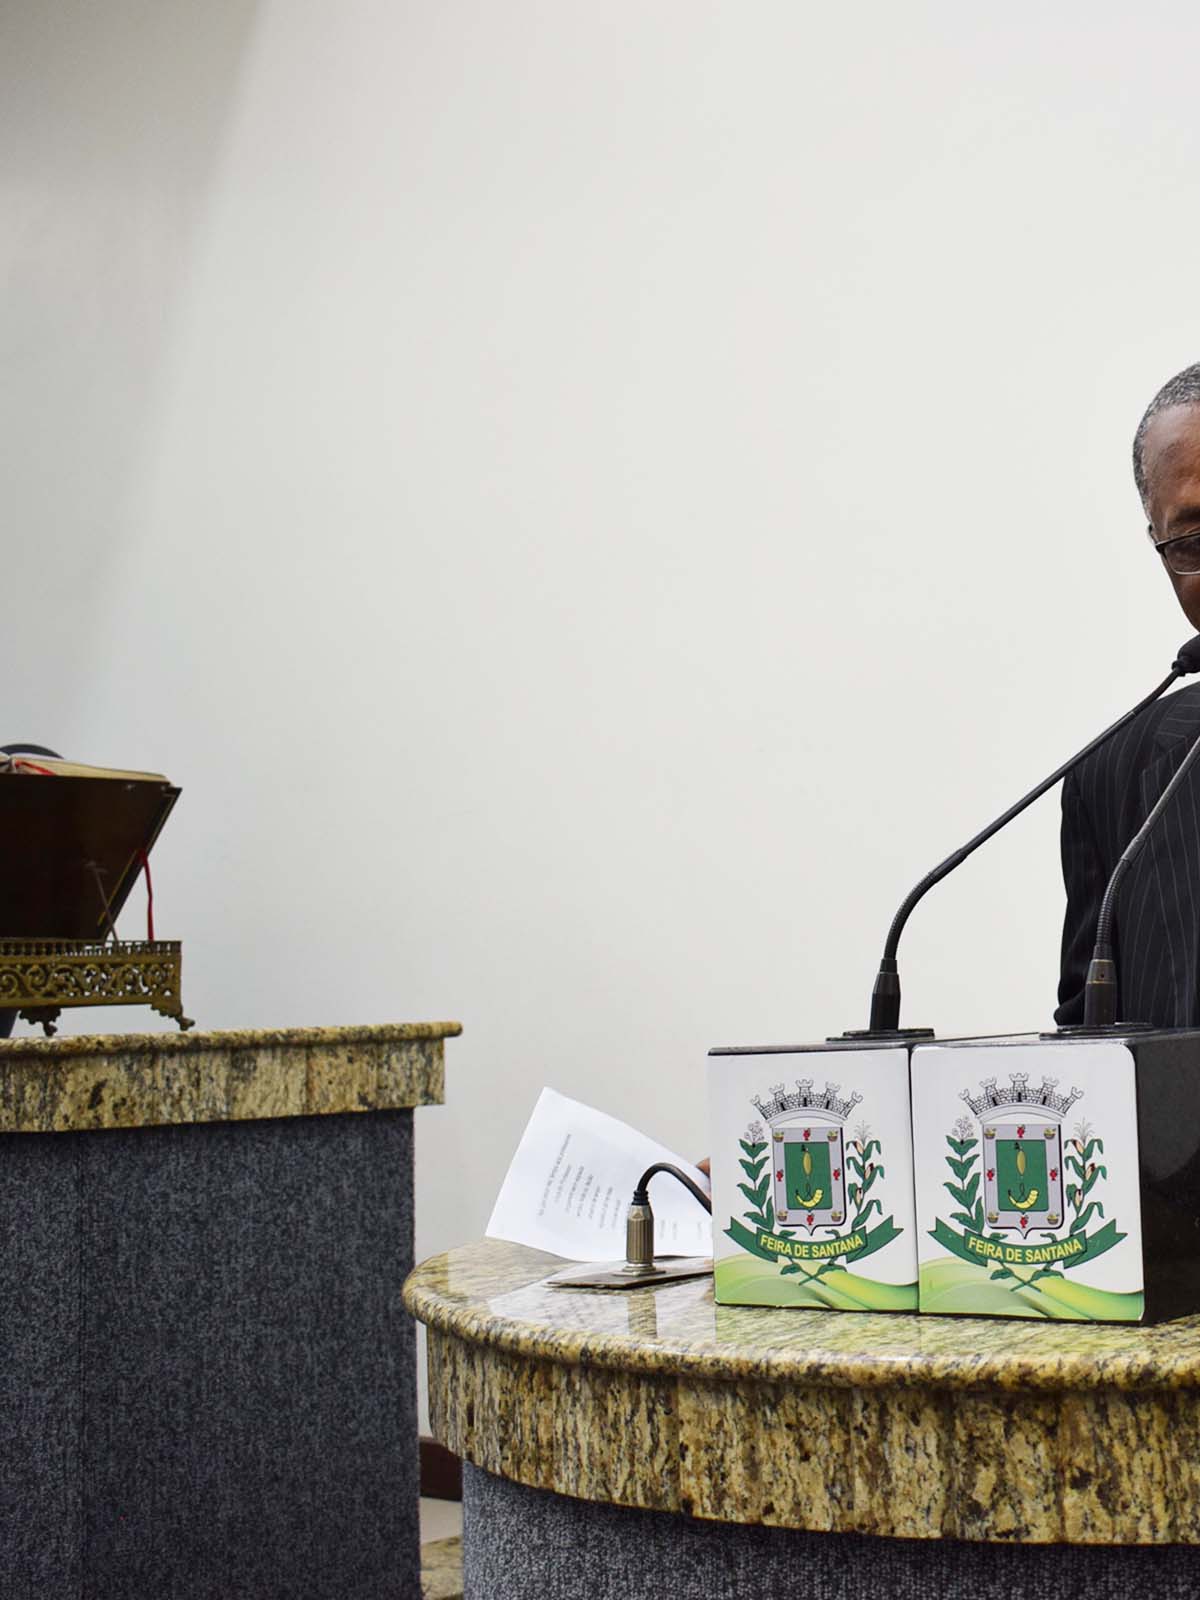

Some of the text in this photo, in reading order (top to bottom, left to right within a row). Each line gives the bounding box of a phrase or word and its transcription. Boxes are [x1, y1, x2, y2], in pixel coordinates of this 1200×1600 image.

[760, 1234, 864, 1258] FEIRA DE SANTANA
[968, 1237, 1082, 1262] FEIRA DE SANTANA
